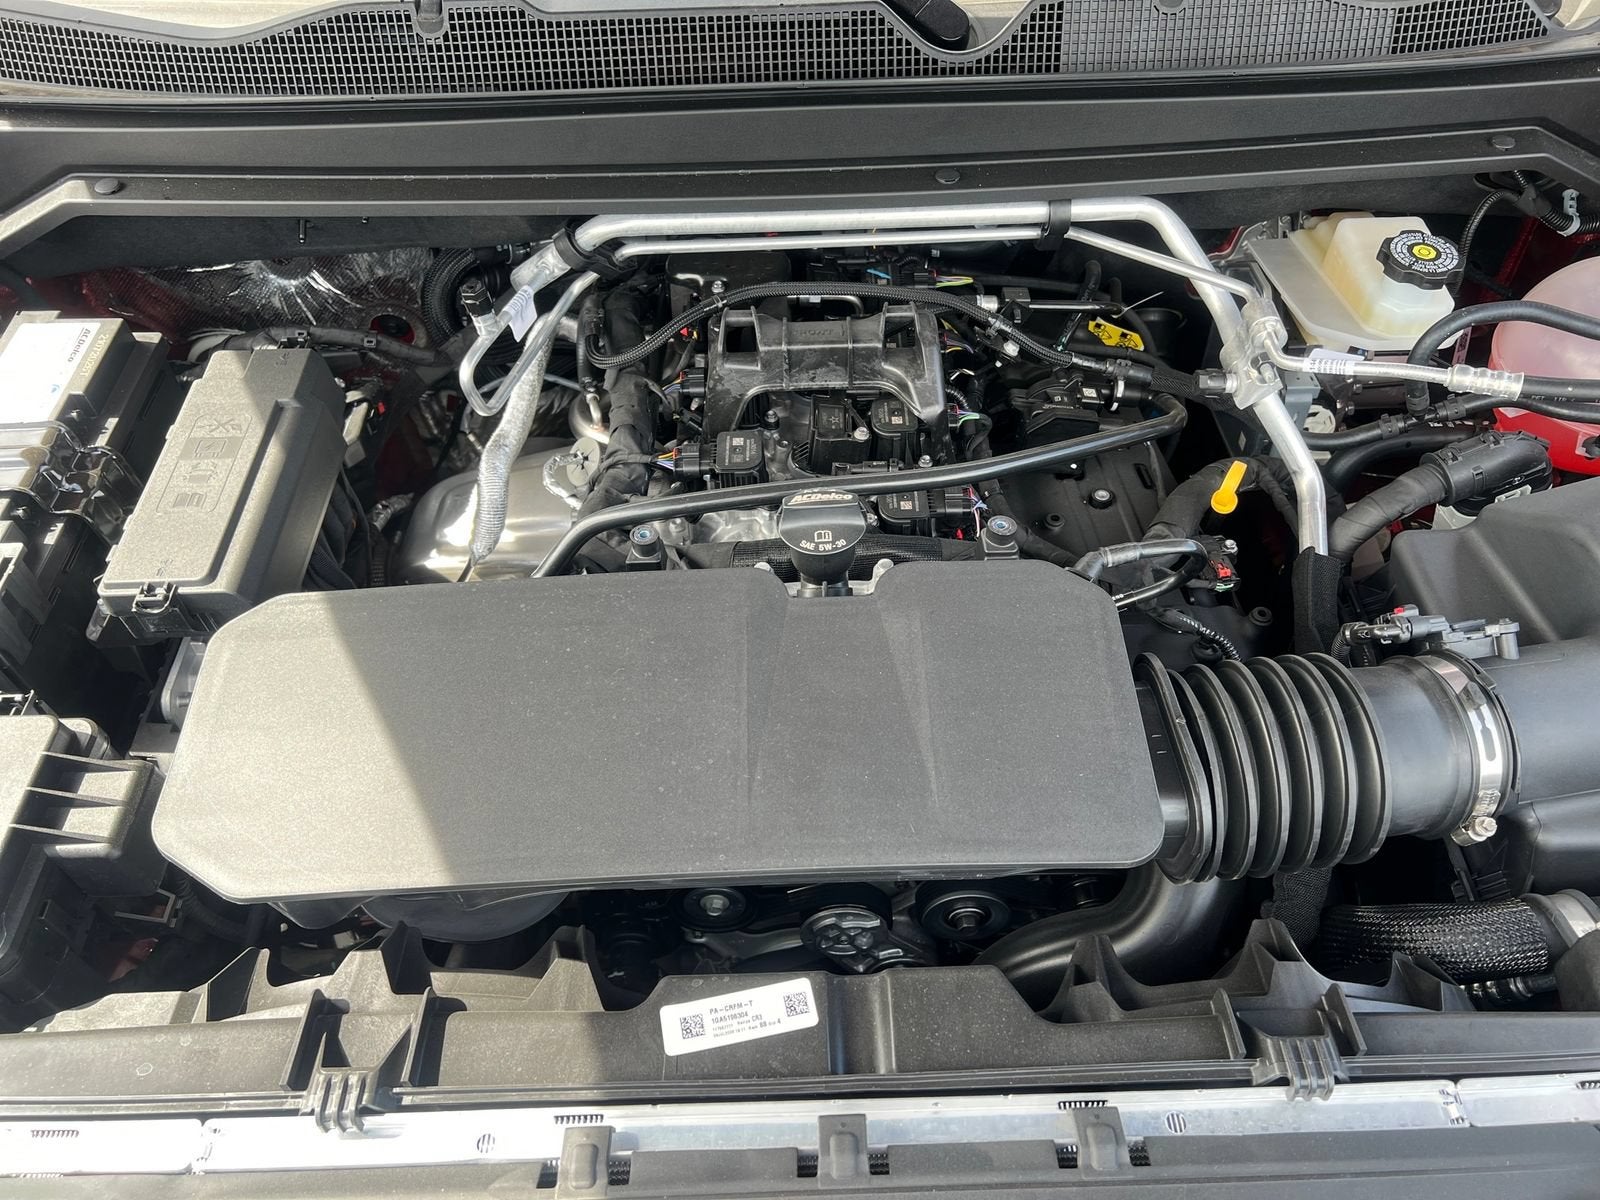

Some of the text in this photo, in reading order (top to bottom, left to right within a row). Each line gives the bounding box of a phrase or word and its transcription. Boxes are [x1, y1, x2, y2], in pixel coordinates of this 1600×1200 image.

[790, 492, 853, 504] ACDelco
[800, 538, 847, 551] SAE 5W-30
